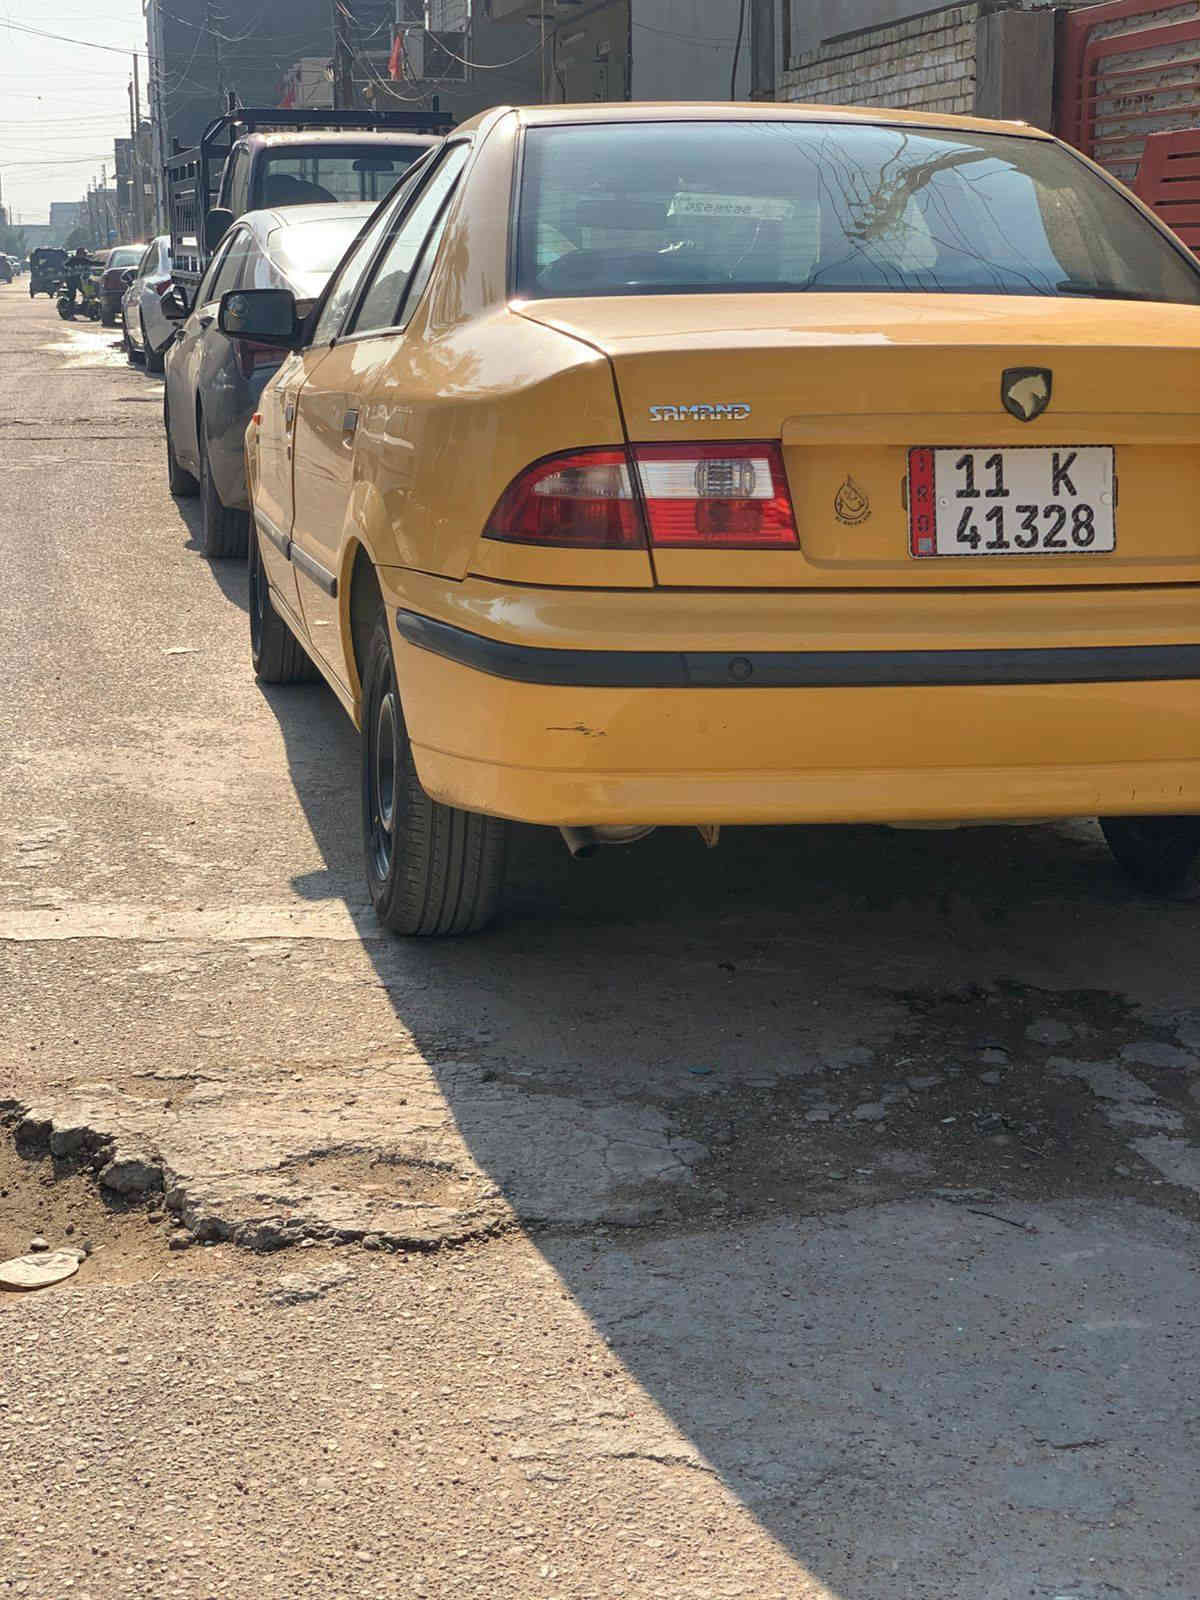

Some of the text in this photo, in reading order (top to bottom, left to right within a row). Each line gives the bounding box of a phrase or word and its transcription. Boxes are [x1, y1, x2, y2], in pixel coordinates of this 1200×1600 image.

[648, 403, 752, 421] SAMAND
[955, 452, 1077, 498] 11 K
[956, 504, 1096, 549] 41328
